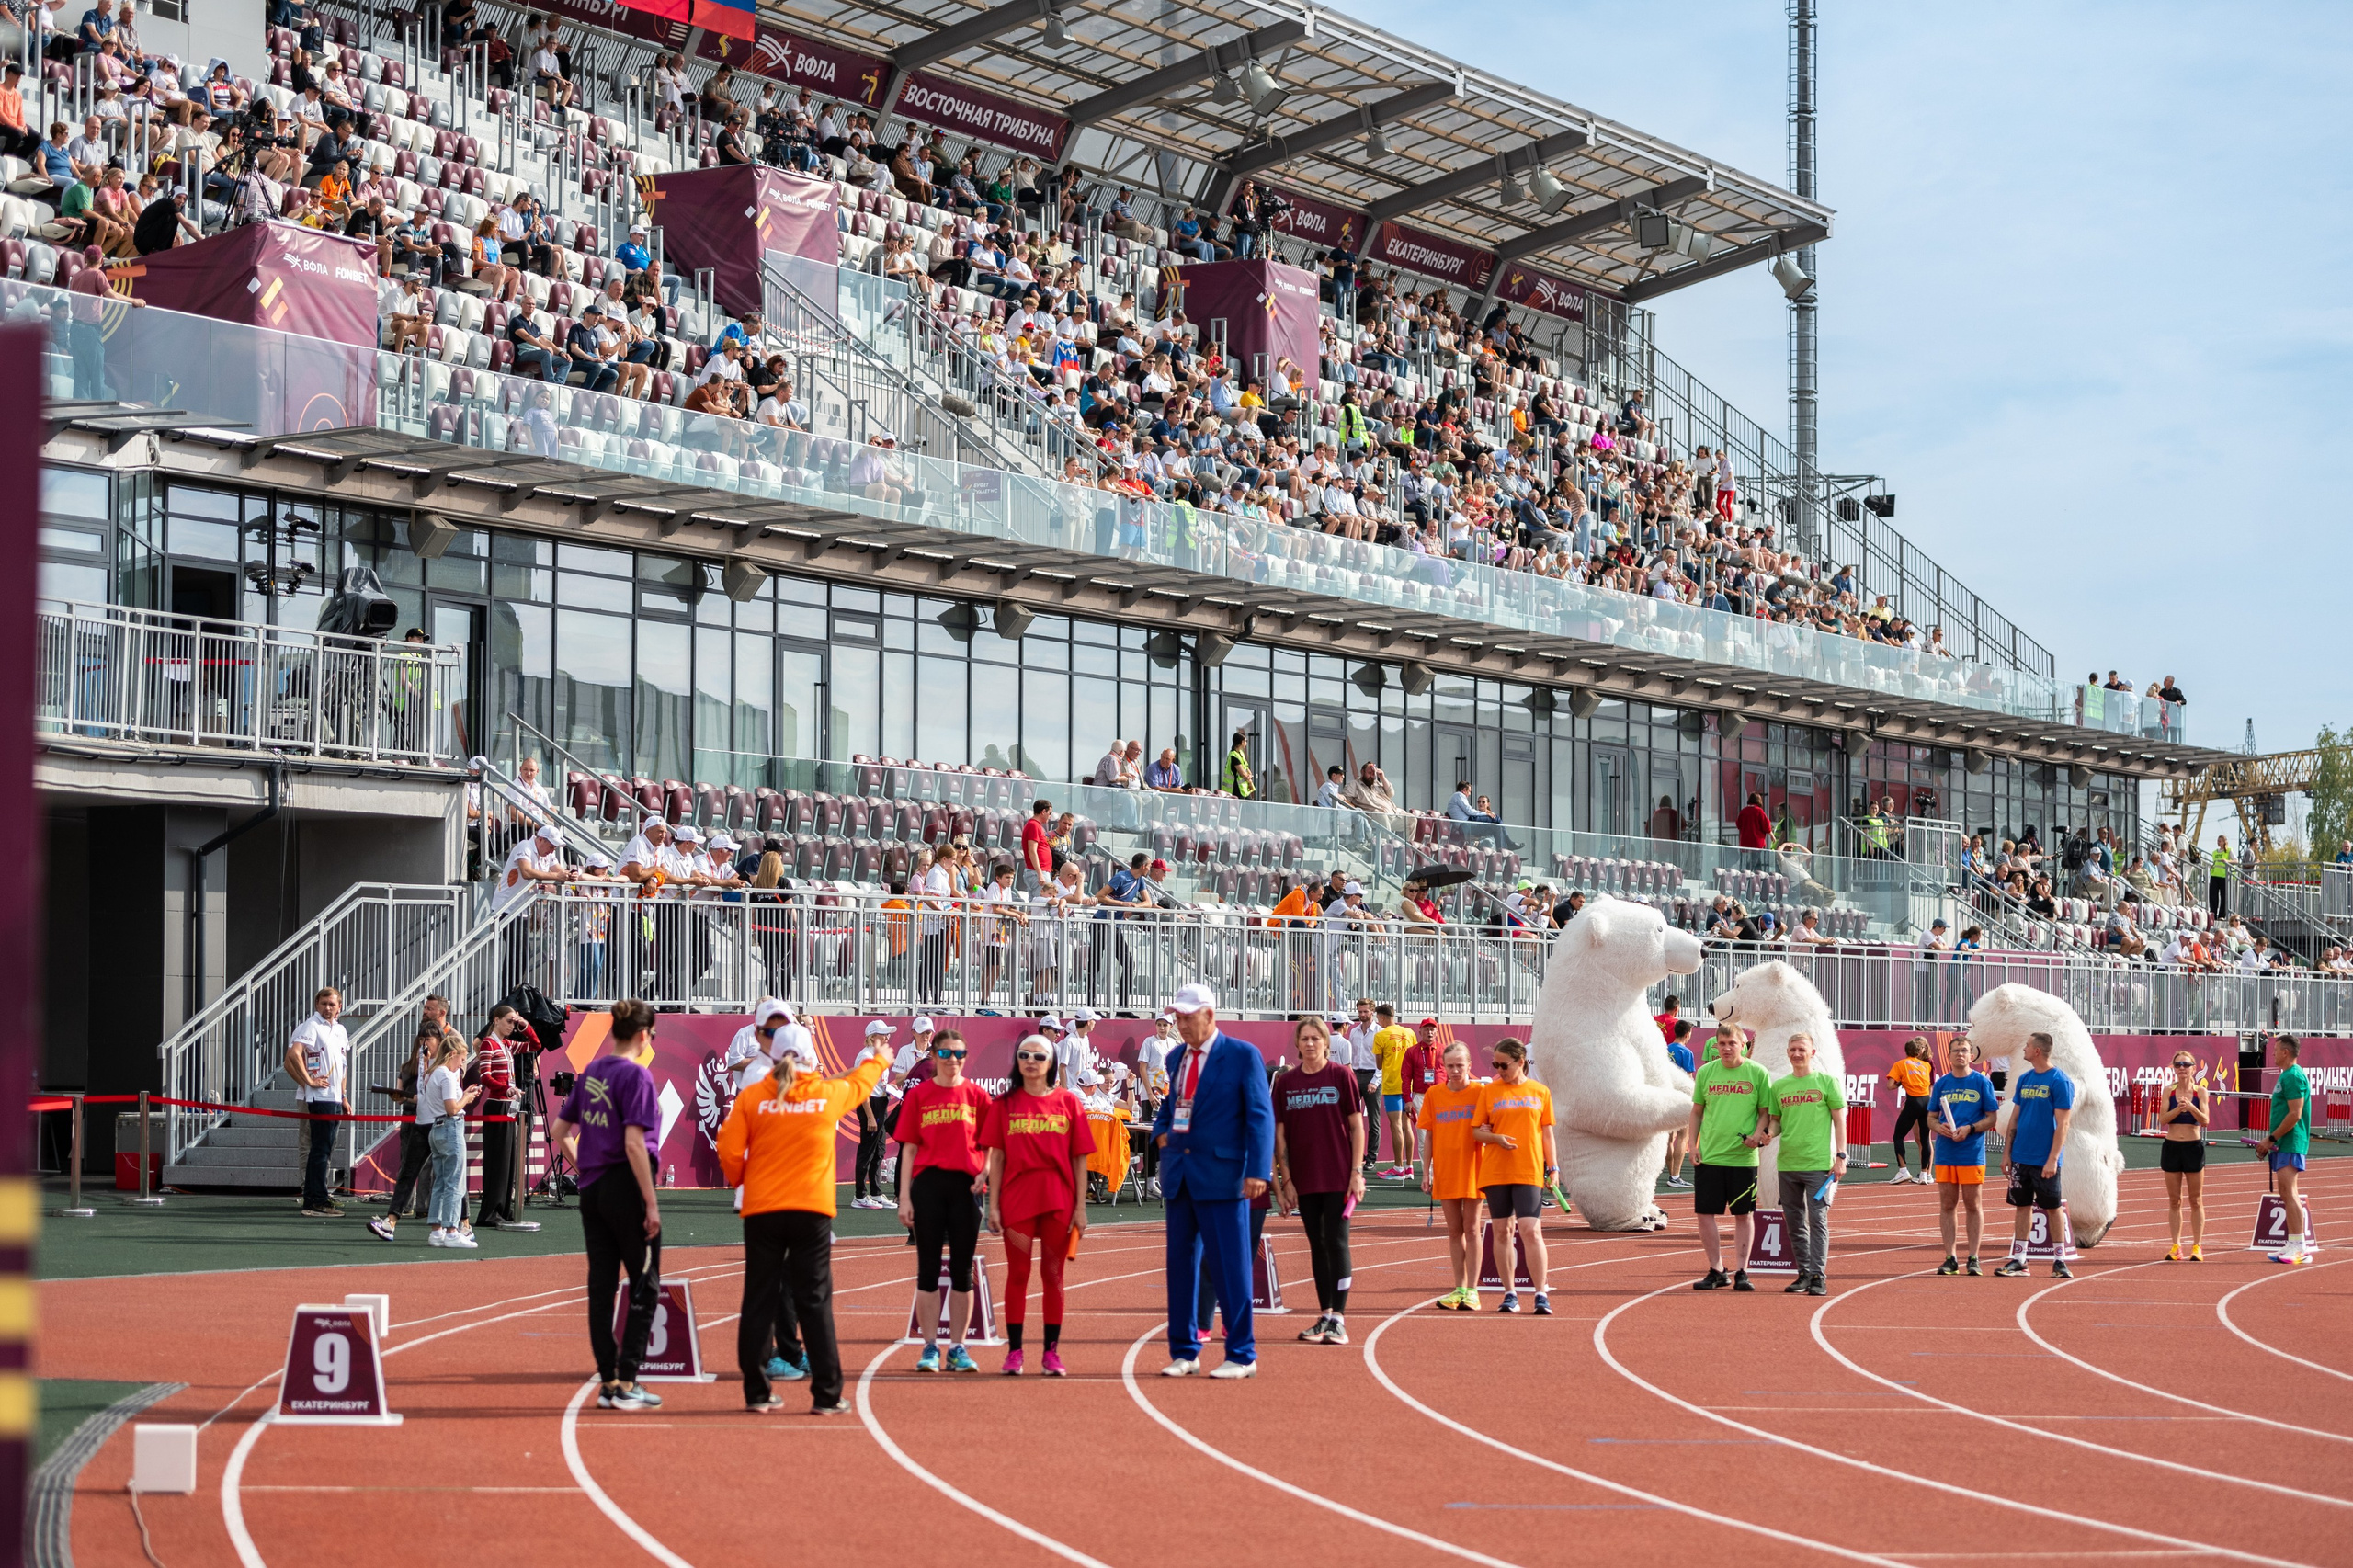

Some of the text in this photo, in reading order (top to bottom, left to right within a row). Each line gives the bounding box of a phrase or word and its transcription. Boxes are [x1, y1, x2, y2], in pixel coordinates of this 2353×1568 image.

[794, 52, 836, 83] ВФЛА
[904, 84, 1055, 148] ВОСТОЧНАЯ ТРИБУНА
[782, 194, 801, 206] ВФЛА
[806, 199, 832, 212] FONBET
[1296, 210, 1326, 233] ВФЛА
[1386, 237, 1465, 275] ЕКАТЕРИНБУРГ
[303, 259, 329, 275] ВФЛА
[335, 267, 368, 283] FONBET
[1558, 291, 1584, 312] ВФЛА
[1709, 1085, 1745, 1095] МЕДИА
[1287, 1093, 1330, 1106] МЕДИА
[1780, 1094, 1813, 1105] МЕДИА
[581, 1109, 609, 1129] ФЛА
[922, 1108, 967, 1121] МЕДИА
[1009, 1119, 1060, 1132] МЕДИА
[2029, 1212, 2047, 1244] 3
[2268, 1206, 2287, 1236] 2
[1761, 1223, 1782, 1256] 4
[1483, 1276, 1529, 1284] ЕКАТЕБУРГ
[313, 1332, 350, 1395] 9
[290, 1399, 370, 1411] ЕКАТЕРИНБУРГ
